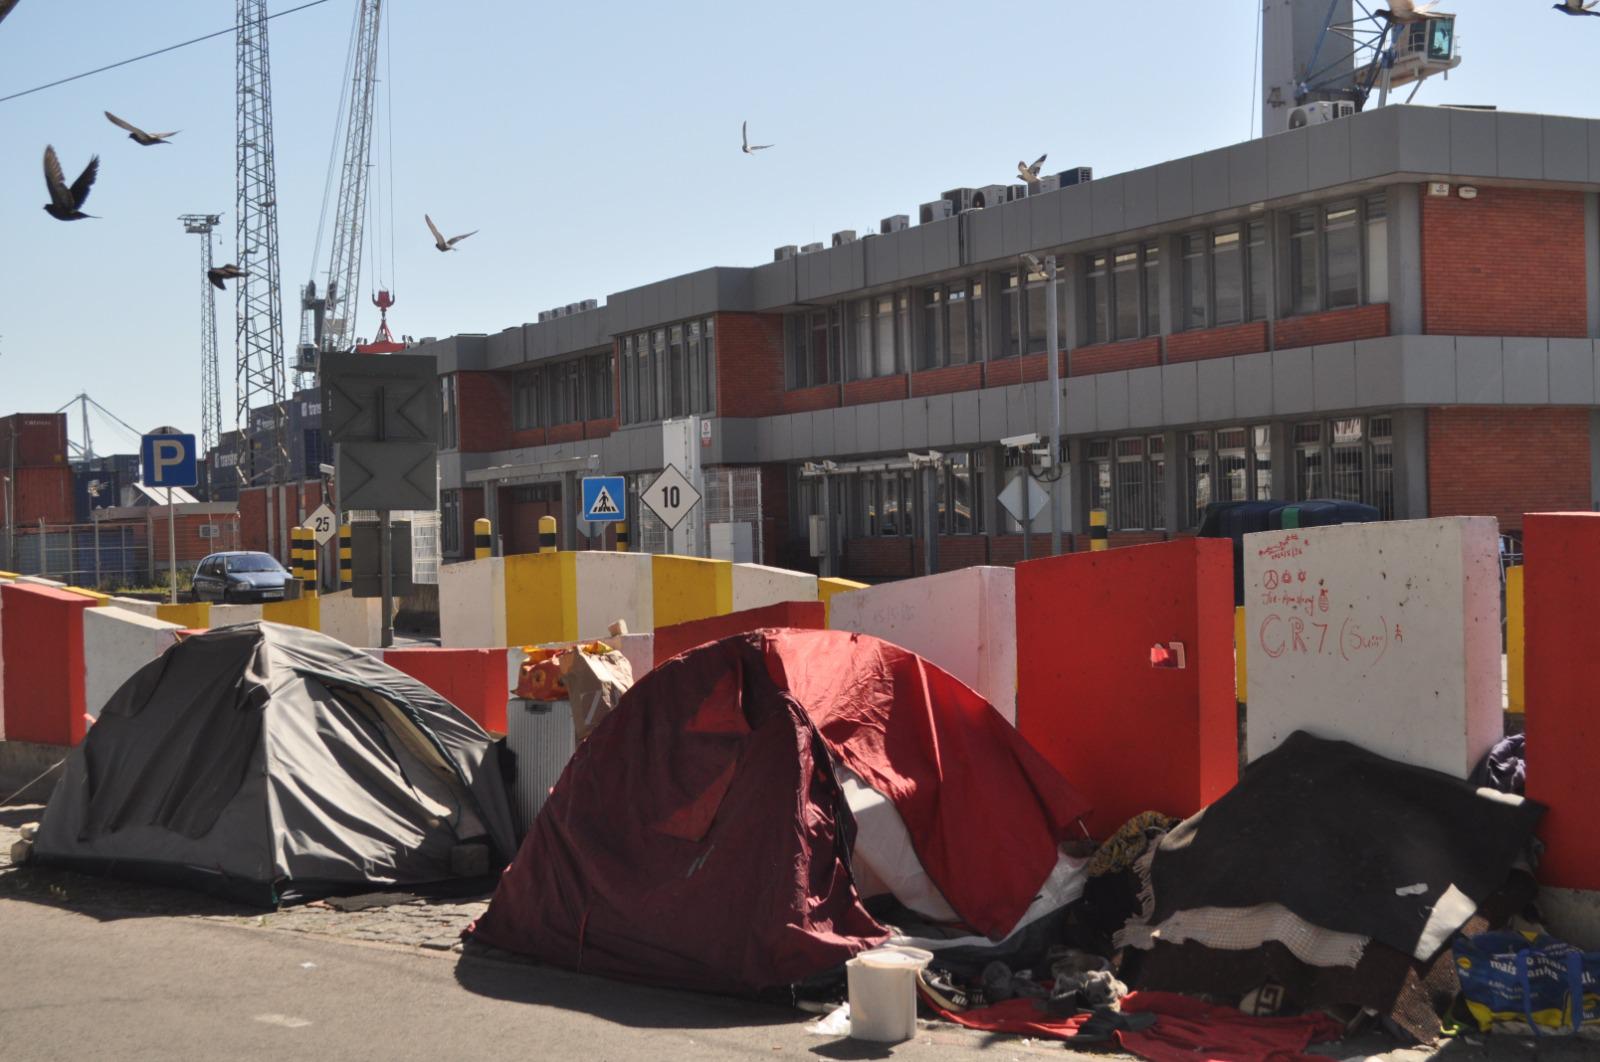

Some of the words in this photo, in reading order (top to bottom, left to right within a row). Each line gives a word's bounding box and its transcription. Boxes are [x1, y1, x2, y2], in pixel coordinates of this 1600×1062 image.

[153, 440, 185, 481] P
[661, 486, 680, 508] 10
[315, 517, 330, 532] 25
[1260, 614, 1328, 658] CR7
[1490, 960, 1517, 975] mais
[1526, 965, 1559, 981] anha
